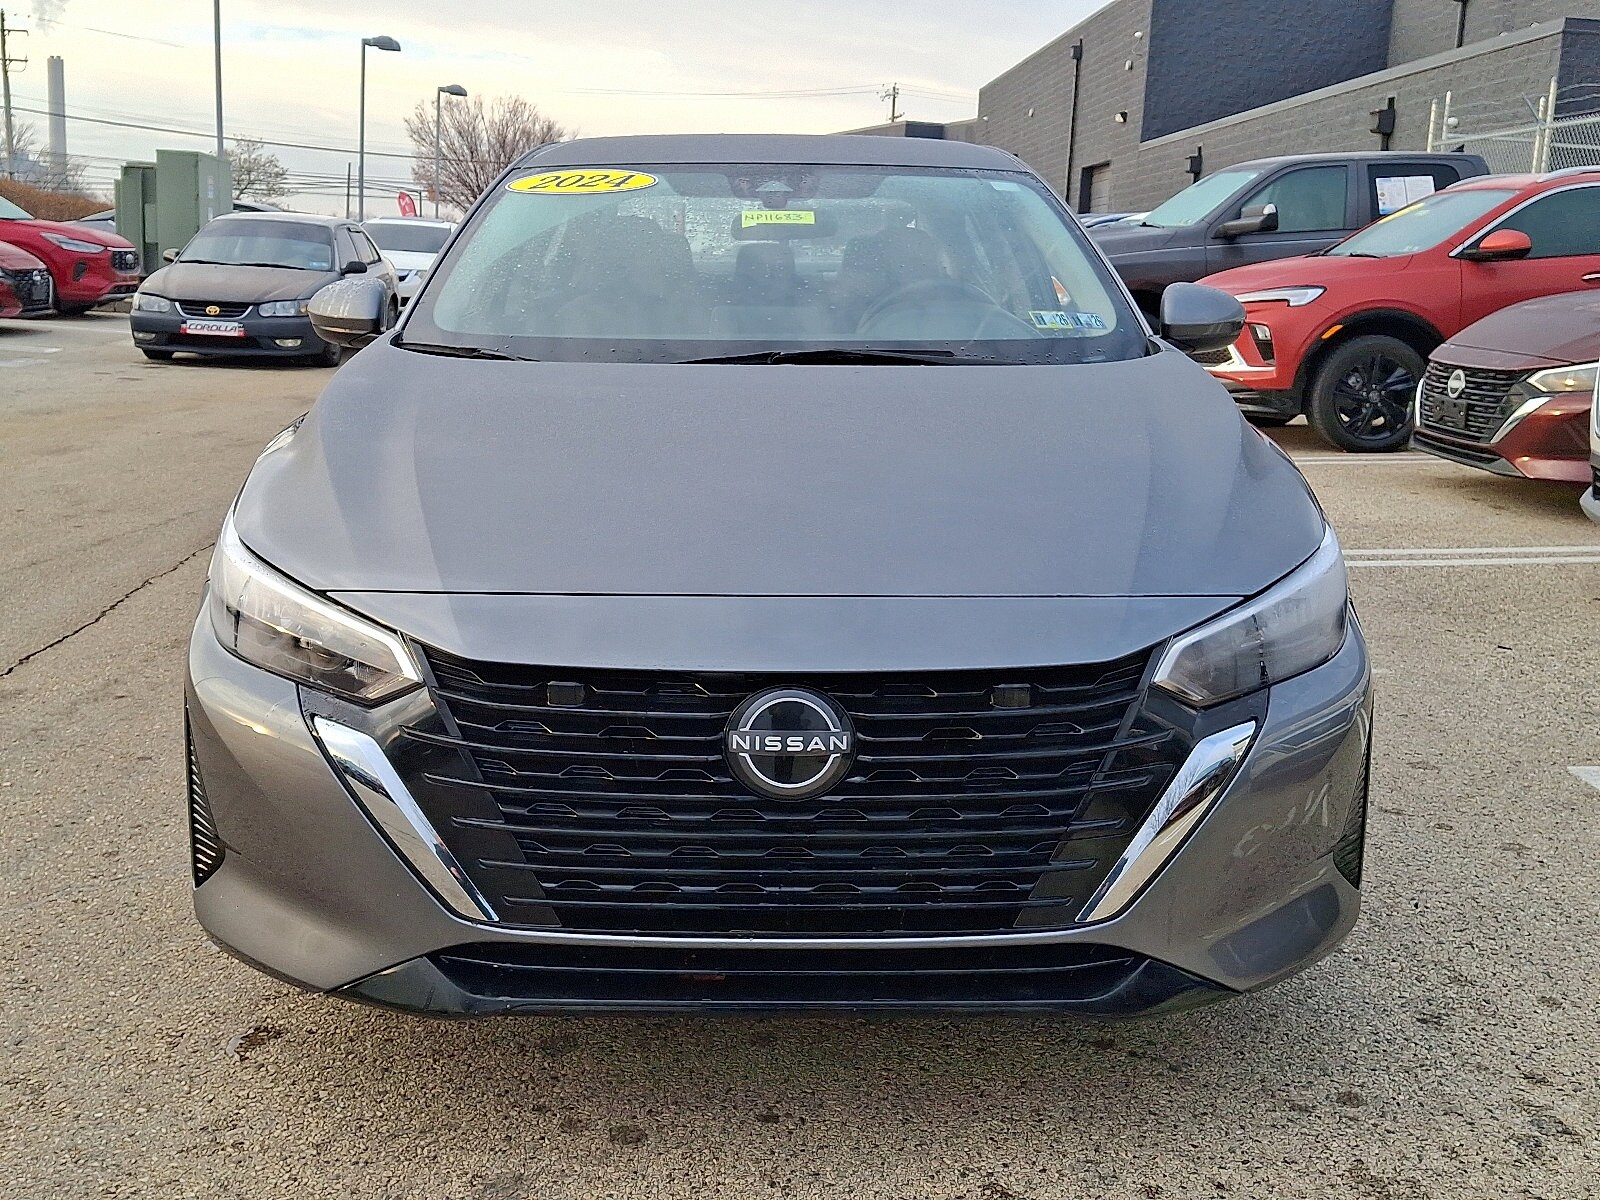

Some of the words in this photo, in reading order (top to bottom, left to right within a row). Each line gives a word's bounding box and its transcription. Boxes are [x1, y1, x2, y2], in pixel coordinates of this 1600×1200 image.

[527, 174, 636, 190] 2024
[188, 323, 237, 333] COROLLA
[732, 734, 847, 752] NISSAN
